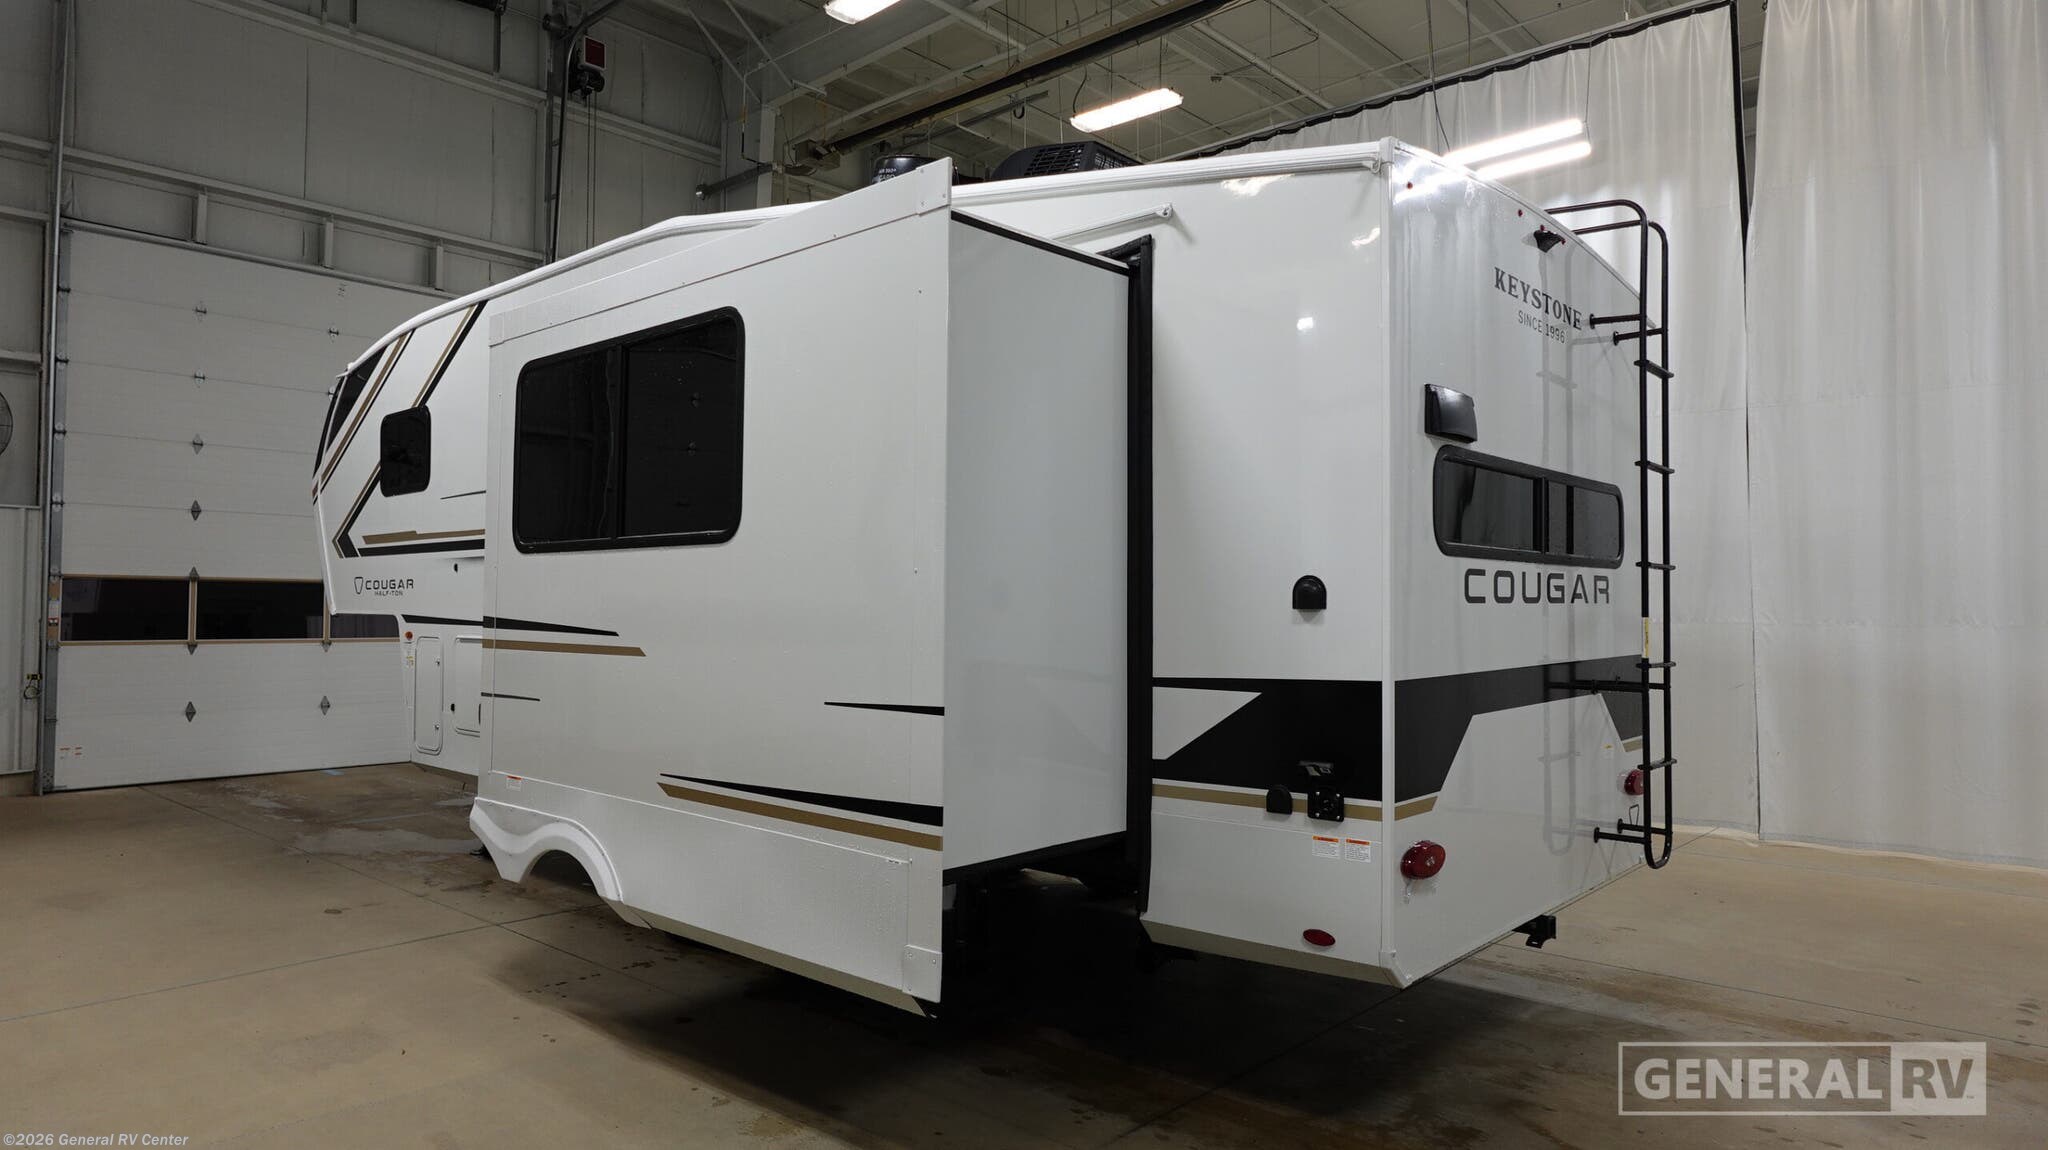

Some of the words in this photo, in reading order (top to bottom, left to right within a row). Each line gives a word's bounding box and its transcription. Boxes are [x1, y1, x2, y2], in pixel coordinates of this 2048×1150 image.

[1494, 266, 1582, 331] KEYSTONE
[1518, 309, 1542, 334] SINCE
[1545, 323, 1566, 344] 1996
[365, 579, 414, 591] COUGAR
[1464, 568, 1610, 604] COUGAR
